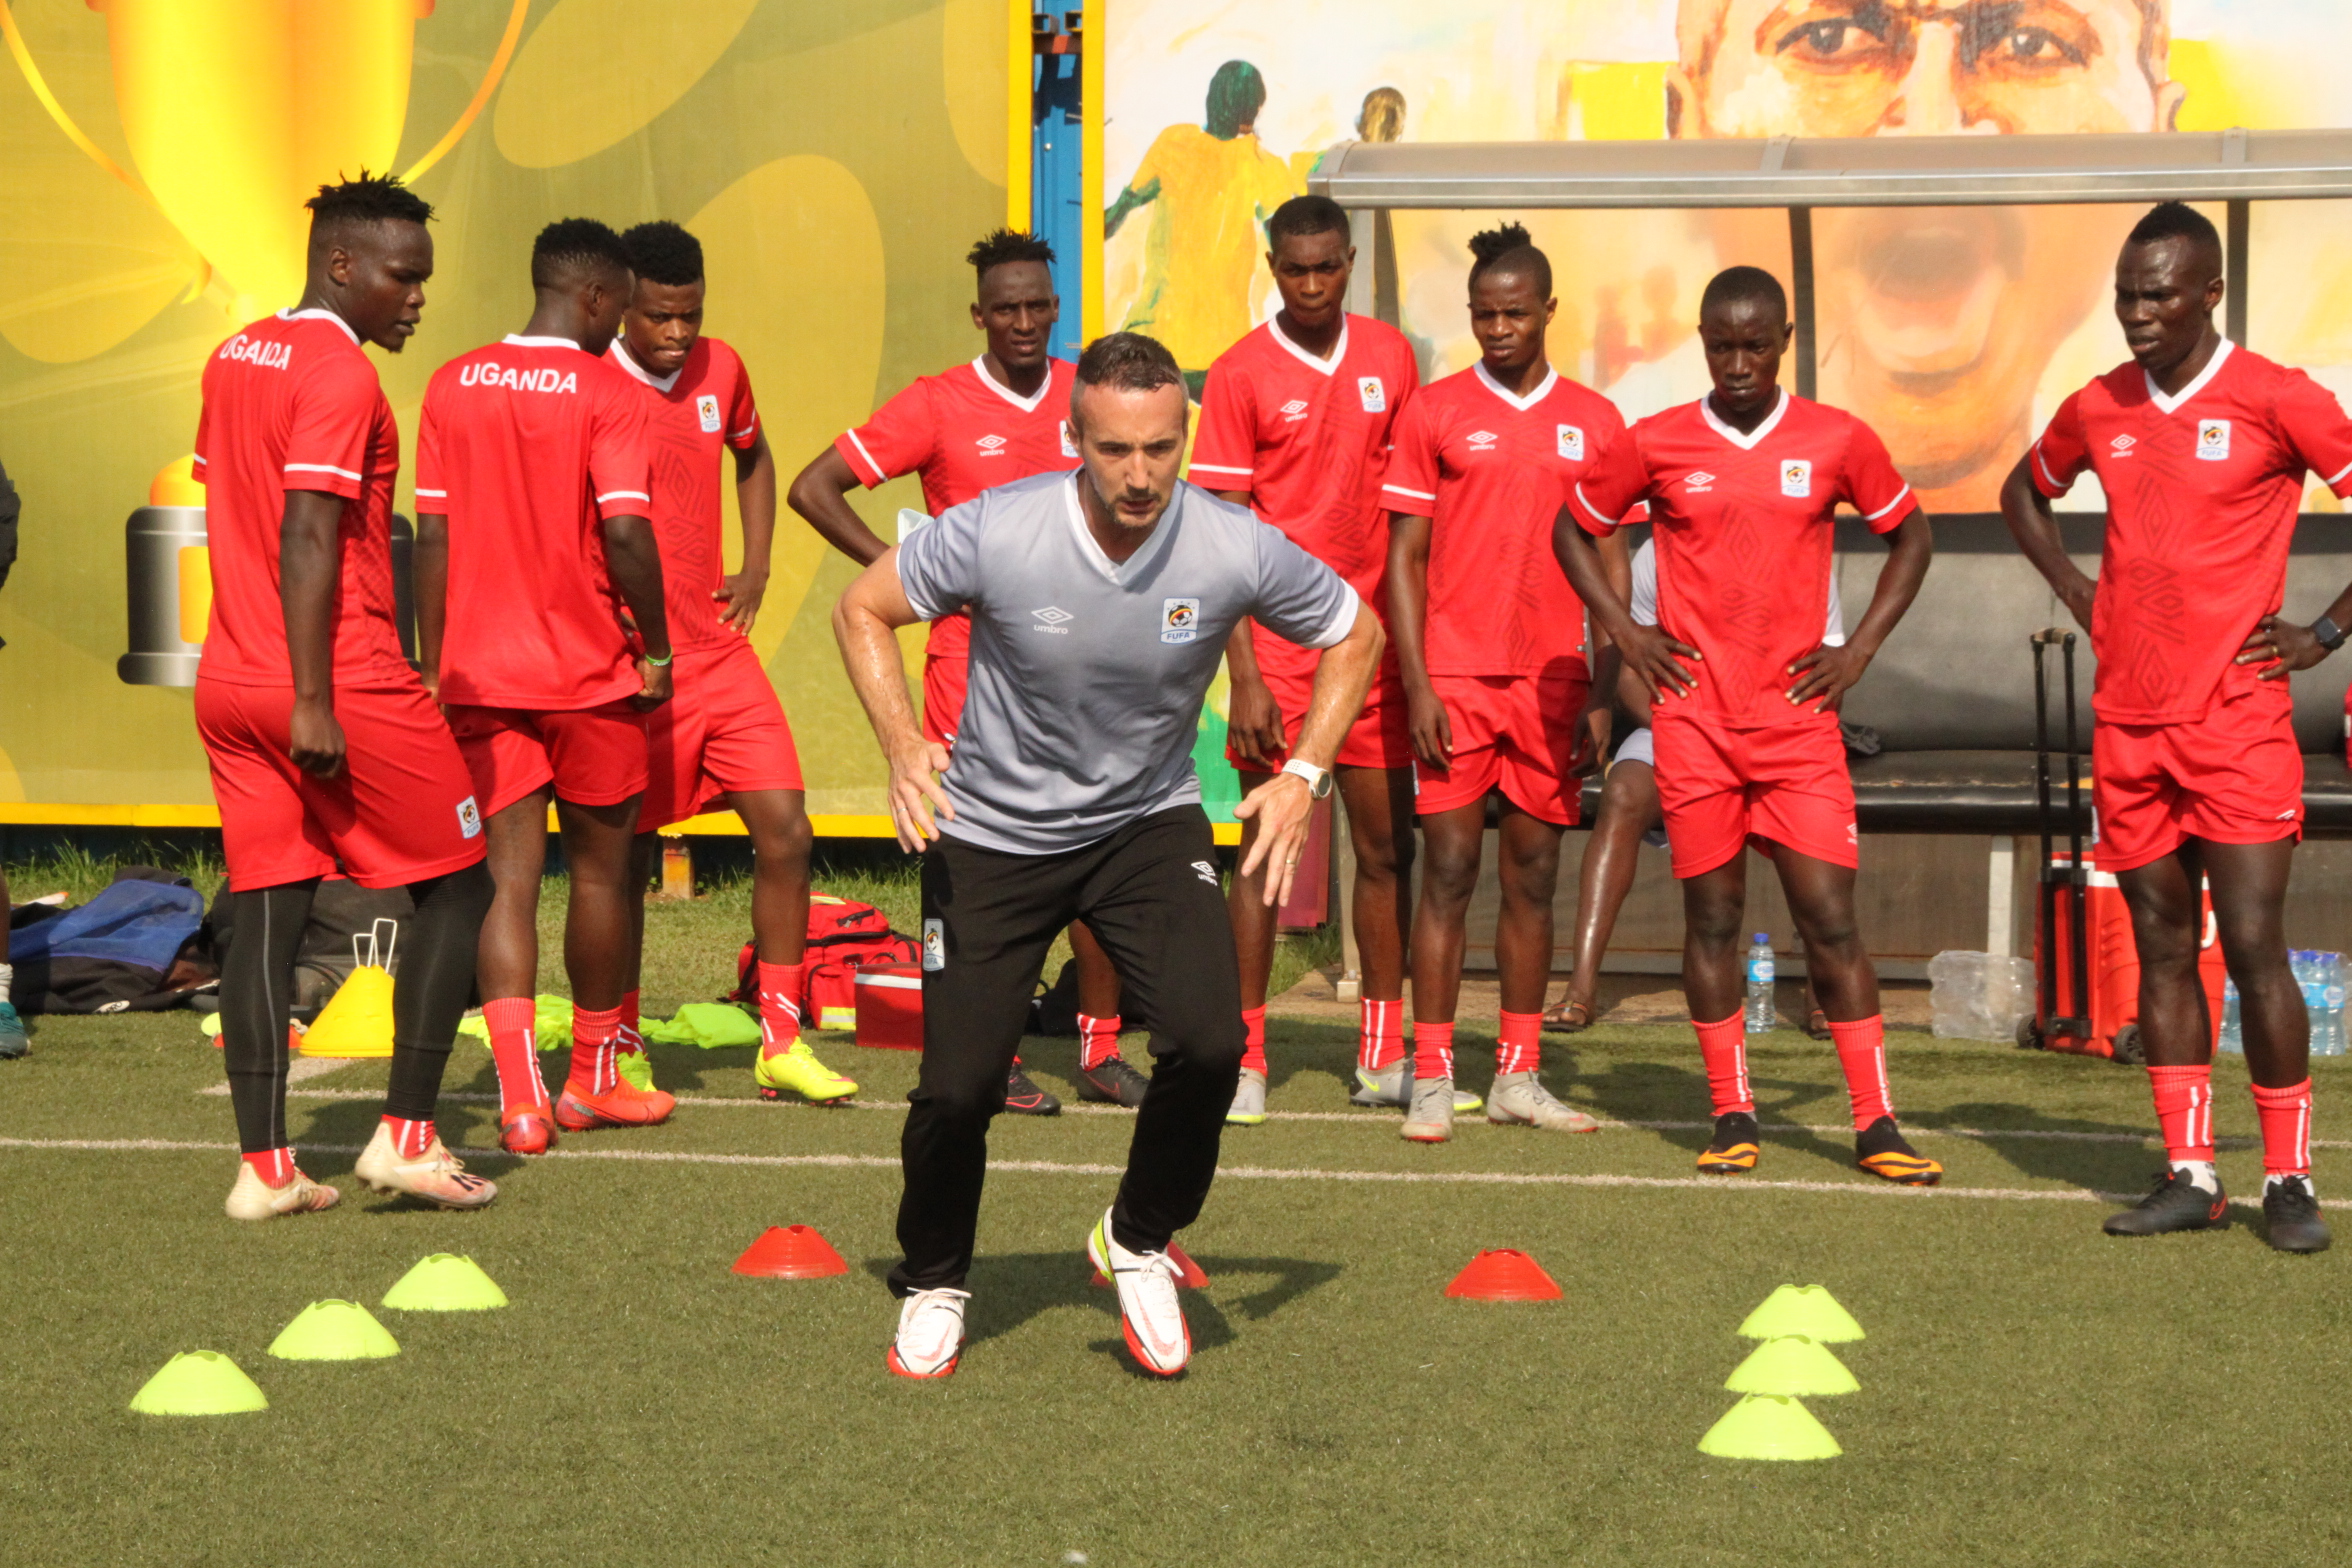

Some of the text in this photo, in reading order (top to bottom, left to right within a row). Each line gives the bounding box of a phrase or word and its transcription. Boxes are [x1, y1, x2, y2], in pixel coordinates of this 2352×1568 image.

[459, 362, 577, 394] UGANDA
[1285, 413, 1308, 422] umbro
[1033, 624, 1068, 634] umbro
[1167, 632, 1190, 640] FUFA
